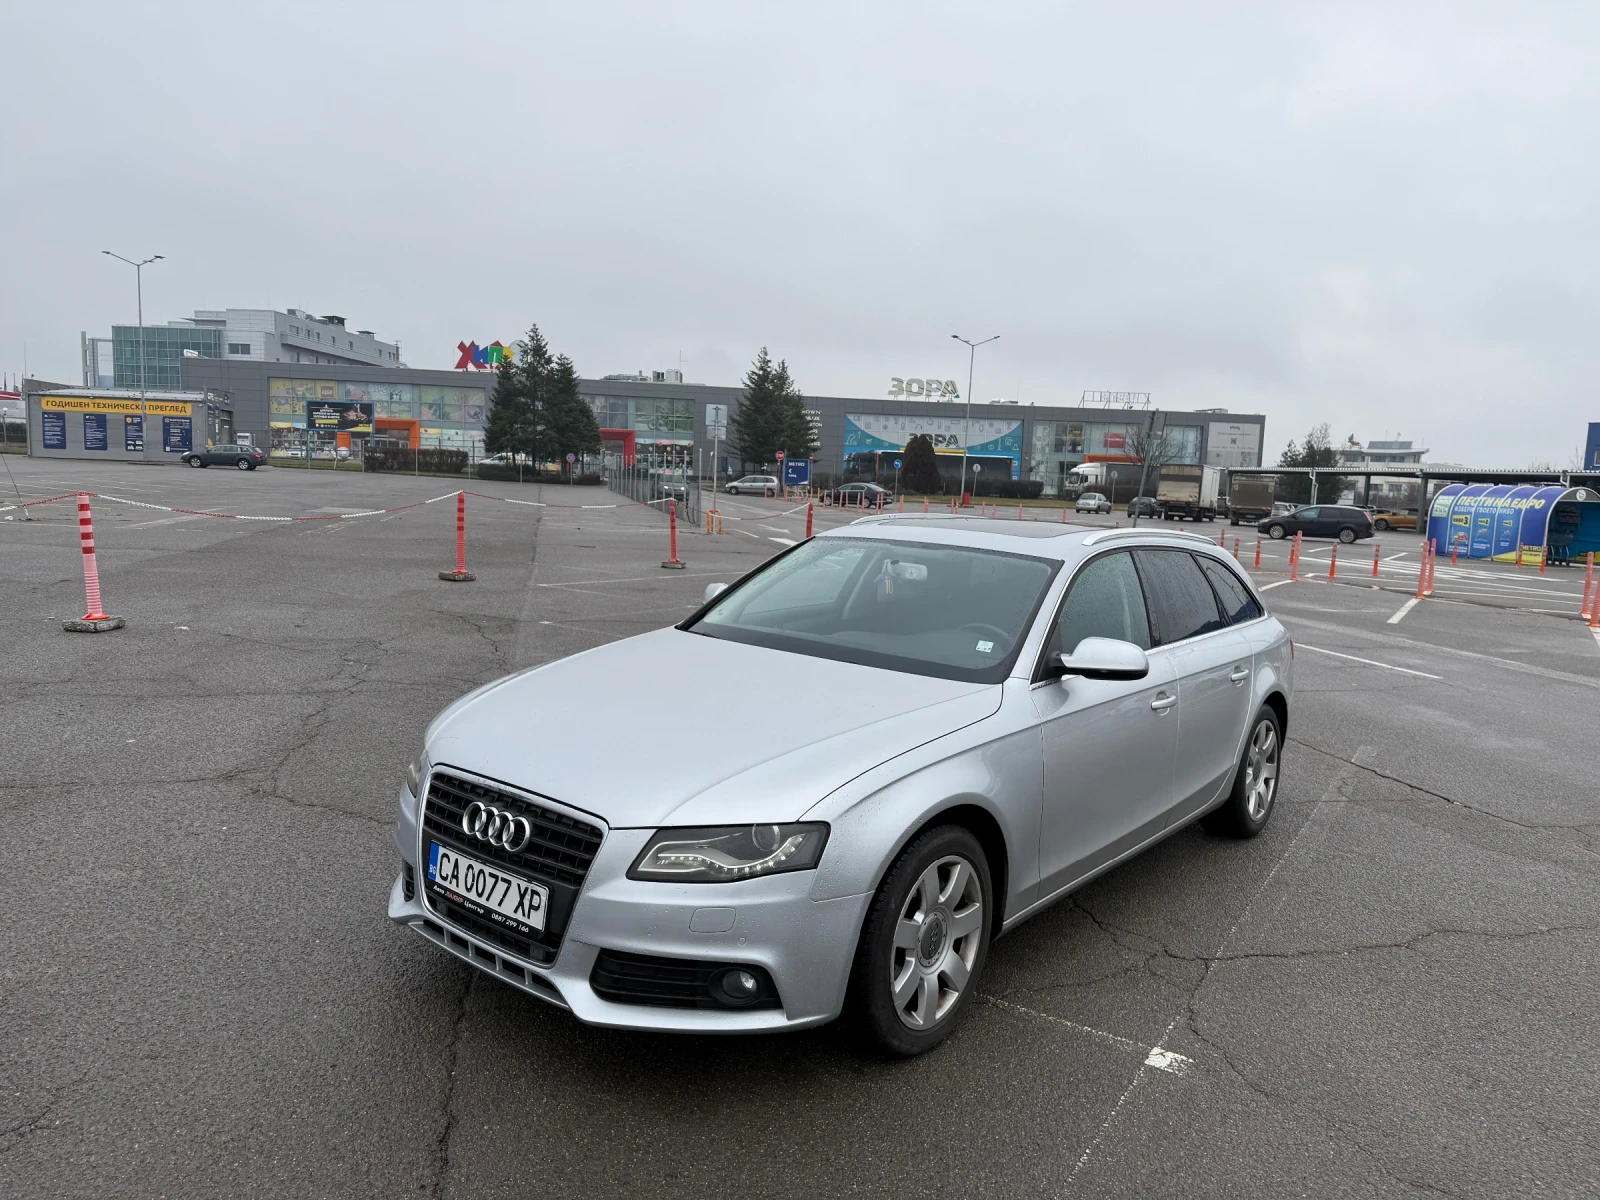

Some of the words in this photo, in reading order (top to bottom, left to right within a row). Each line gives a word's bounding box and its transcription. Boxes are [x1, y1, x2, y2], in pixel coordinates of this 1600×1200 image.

[888, 377, 960, 398] ЗОРА
[46, 400, 90, 409] ГОДИШЕН
[148, 404, 187, 413] ПРЕГЛЕД
[1458, 496, 1495, 506] ПЕСТИ
[1493, 497, 1511, 507] НА
[1511, 498, 1546, 510] ЕДРО
[1463, 516, 1469, 525] 3
[884, 579, 894, 594] 10
[429, 864, 437, 875] BG
[465, 864, 511, 906] 0077
[433, 885, 444, 894] Авто
[464, 901, 484, 914] Център
[491, 913, 505, 922] 0887
[506, 919, 518, 928] 299
[518, 924, 529, 933] 166
